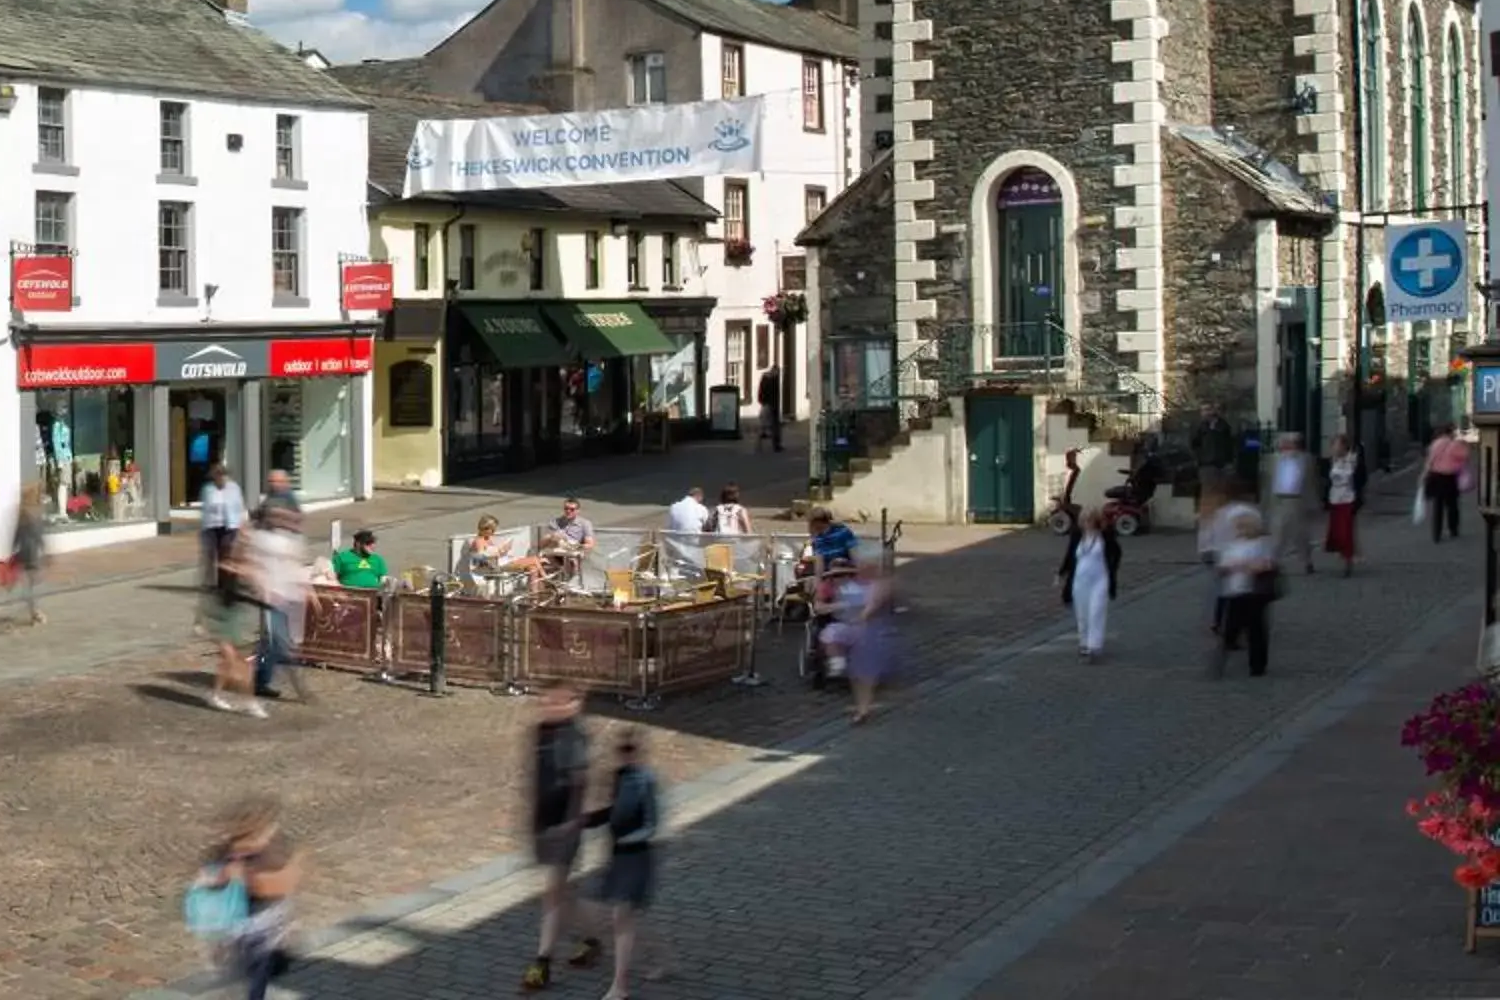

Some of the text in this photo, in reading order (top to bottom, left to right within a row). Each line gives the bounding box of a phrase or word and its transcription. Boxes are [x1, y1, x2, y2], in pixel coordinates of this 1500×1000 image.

[512, 125, 612, 147] WELCOME
[480, 155, 562, 176] KESWICK
[564, 146, 690, 172] CONVENTION
[1389, 303, 1463, 317] Pharmacy
[25, 366, 128, 382] cotswoldoutdoor.com
[180, 361, 247, 379] COTSWOLD
